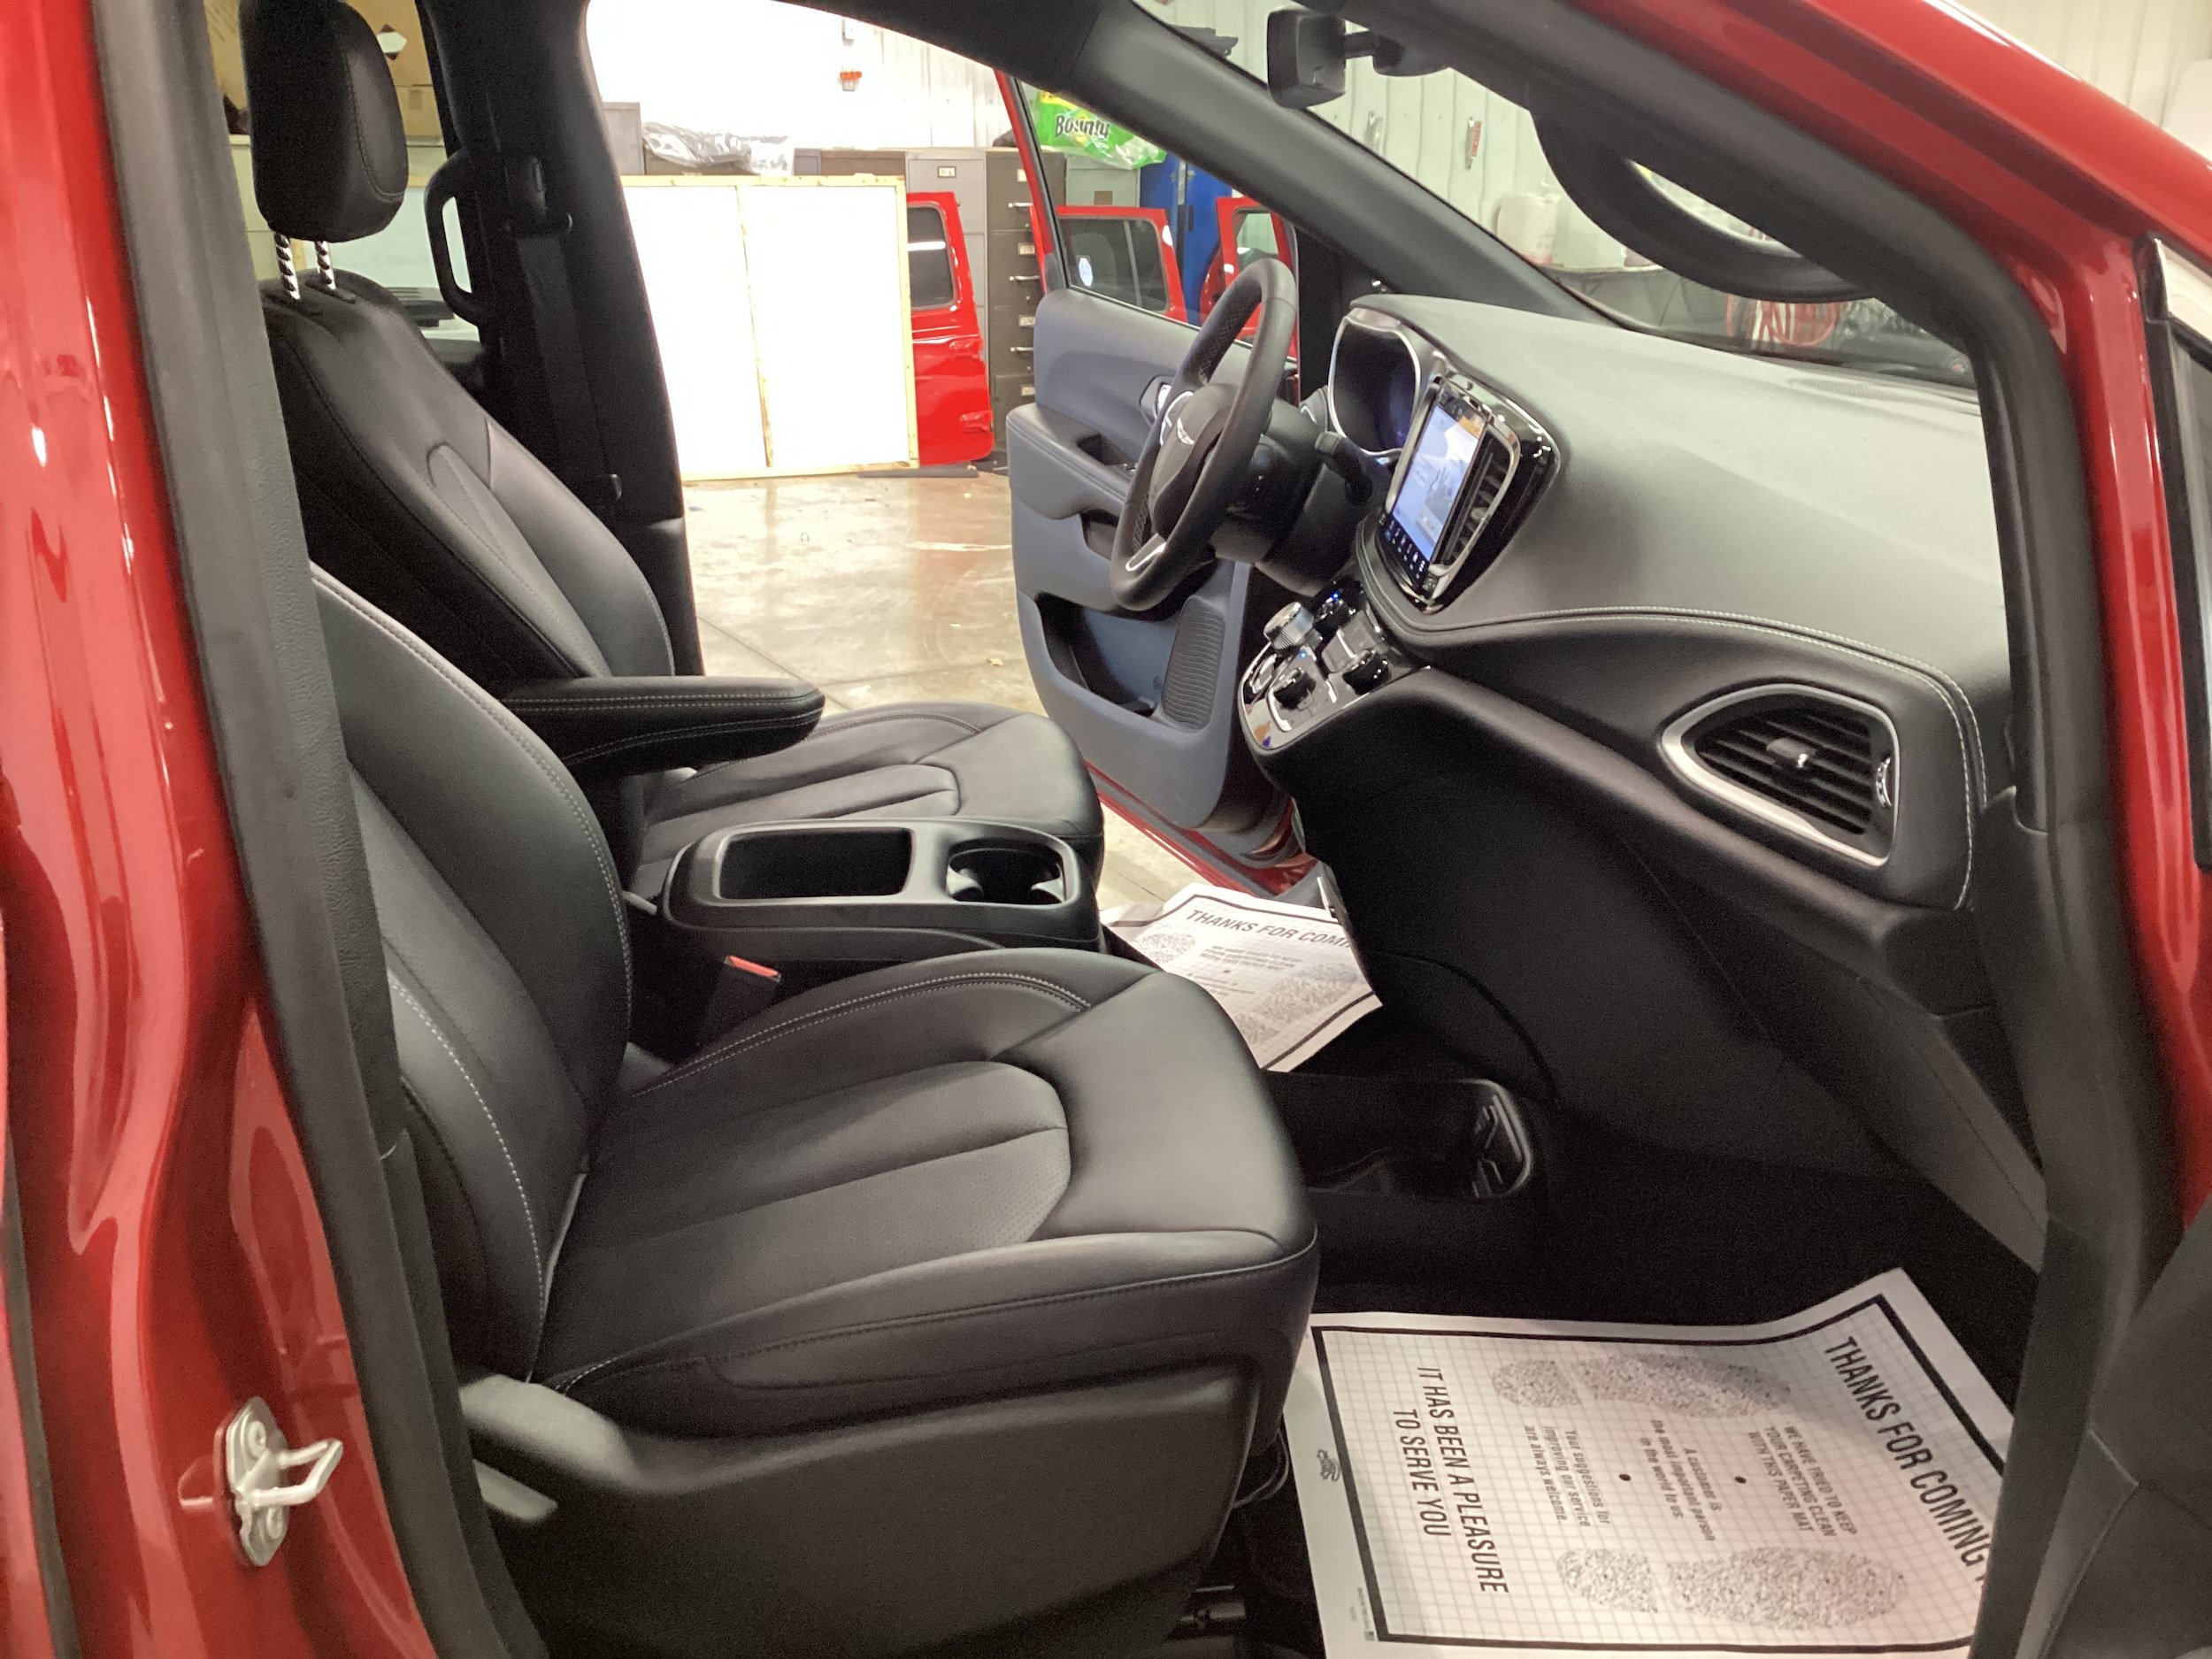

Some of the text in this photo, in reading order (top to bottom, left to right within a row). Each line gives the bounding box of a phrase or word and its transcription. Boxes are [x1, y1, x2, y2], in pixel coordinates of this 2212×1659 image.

[1055, 115, 1110, 141] Bounty
[1187, 910, 1258, 932] THANKS
[1256, 926, 1299, 939] FOR
[1393, 1409, 1451, 1536] TO SERVE YOU
[1417, 1367, 1509, 1593] IT HAS BEEN A PLEASURE
[1524, 1425, 1539, 1440] are
[1531, 1443, 1551, 1476] always
[1543, 1426, 1591, 1527] improving our service
[1565, 1430, 1610, 1525] Your suggestions for
[1650, 1419, 1716, 1540] the most important person
[1652, 1465, 1676, 1491] world
[1687, 1457, 1717, 1500] customer
[1747, 1432, 1815, 1532] WITH THIS PAPER MAT
[1764, 1426, 1837, 1536] YOUR CARPETING CLEAN
[1784, 1426, 1858, 1534] WE HAVE TRIED TO KEEP
[1824, 1336, 1992, 1567] THANKS FOR COMING
